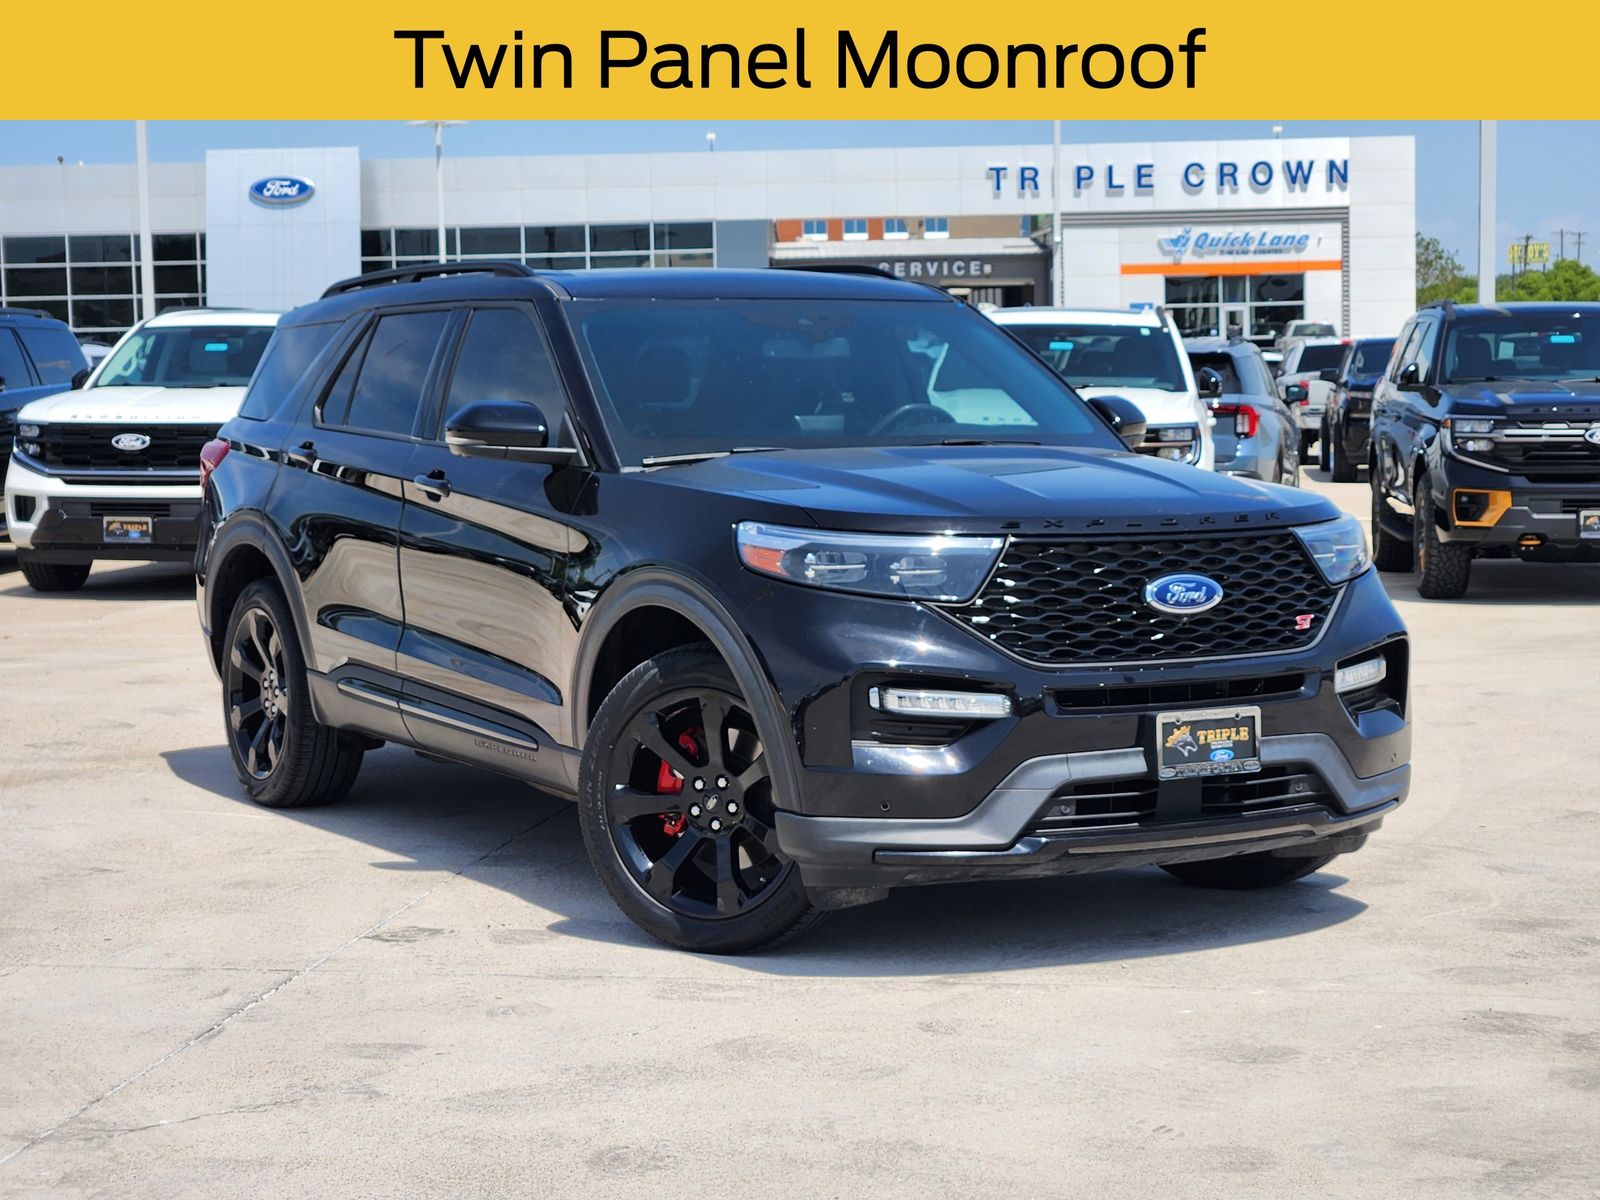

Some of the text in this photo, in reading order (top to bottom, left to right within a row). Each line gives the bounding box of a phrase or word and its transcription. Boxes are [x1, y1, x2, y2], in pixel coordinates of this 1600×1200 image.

[988, 160, 1349, 191] TRPLE CROWN
[263, 180, 300, 196] Ford
[1194, 230, 1310, 250] Quick Lane
[1165, 581, 1207, 604] Ford
[1196, 726, 1250, 745] TRIPLE
